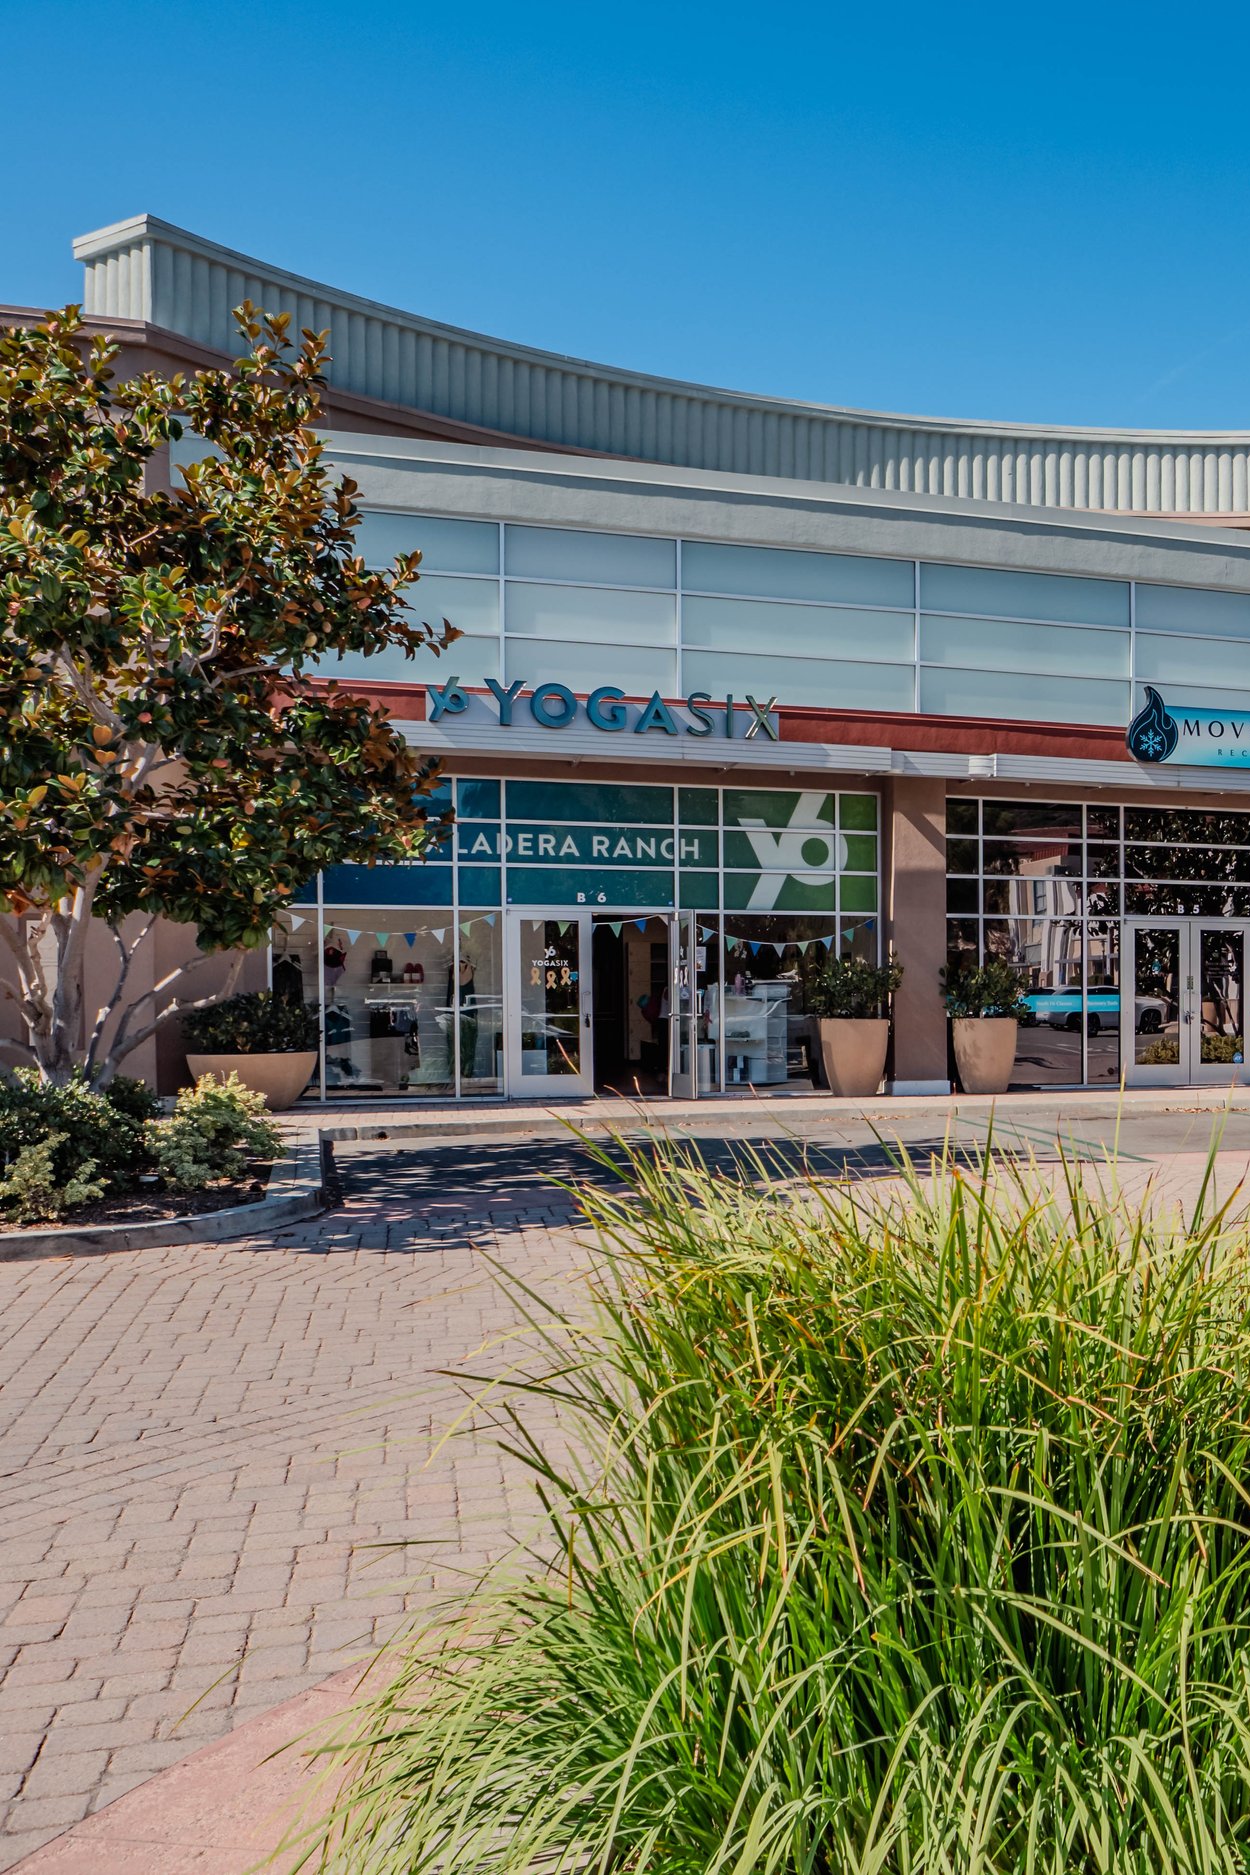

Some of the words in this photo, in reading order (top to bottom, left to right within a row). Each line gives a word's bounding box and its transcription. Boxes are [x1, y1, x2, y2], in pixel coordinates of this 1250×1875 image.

[484, 678, 778, 741] YOGASIX
[457, 832, 580, 858] LADERA
[591, 836, 700, 861] RANCH
[577, 892, 586, 903] B
[597, 892, 607, 903] 6
[532, 959, 569, 967] YOGASIX
